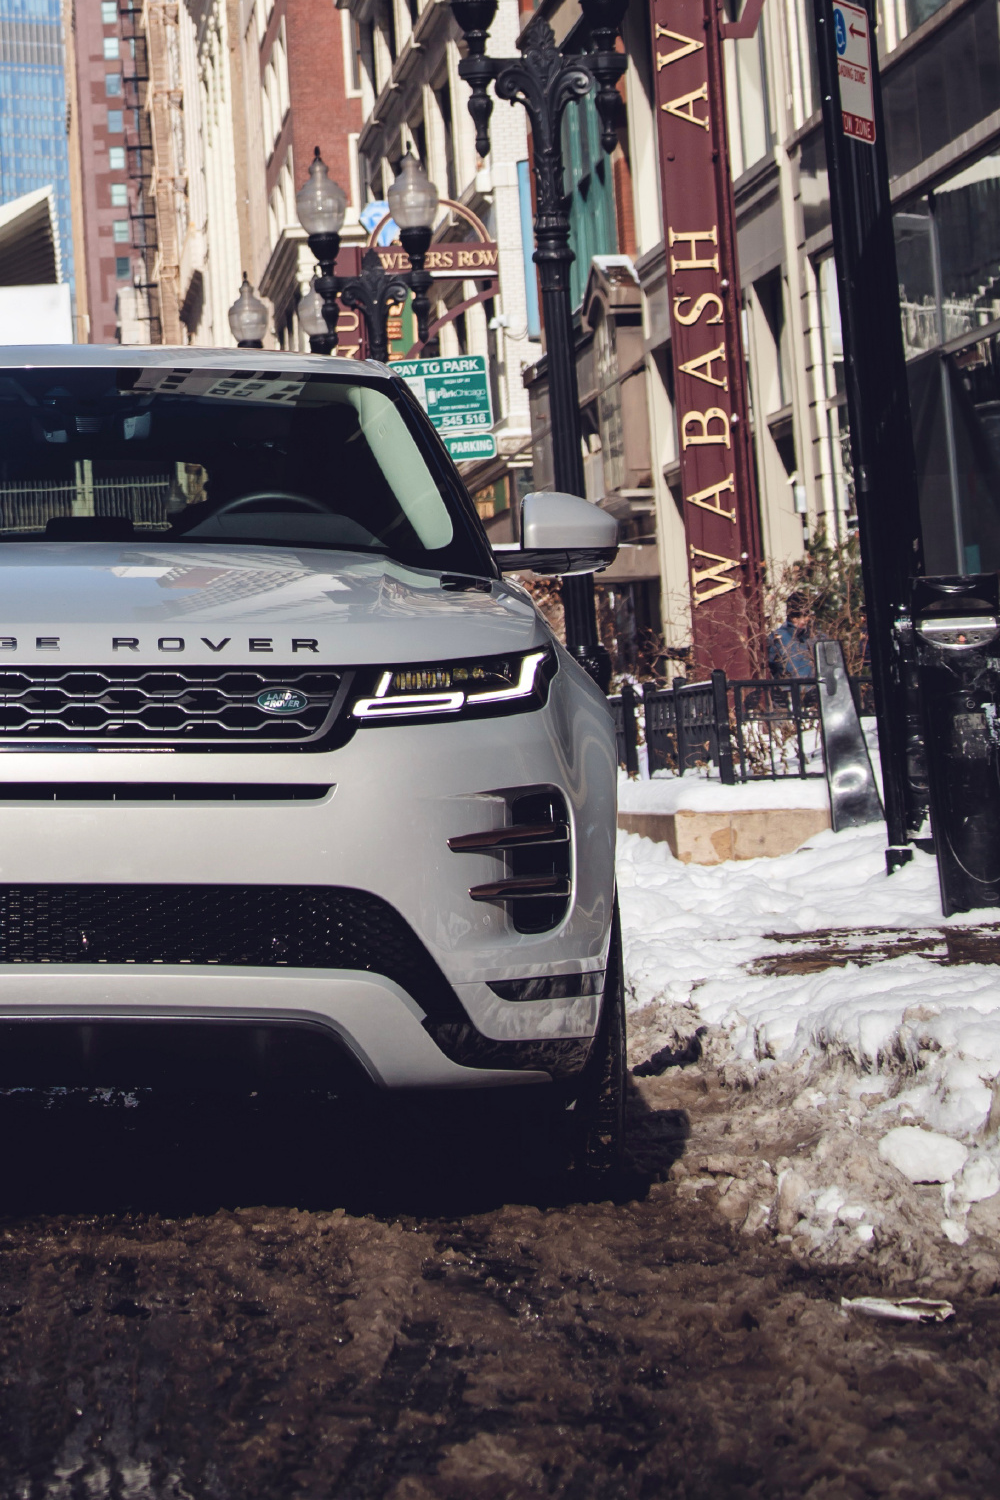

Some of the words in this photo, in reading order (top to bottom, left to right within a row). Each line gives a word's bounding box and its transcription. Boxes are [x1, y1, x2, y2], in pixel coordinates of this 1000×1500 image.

[854, 70, 867, 85] ZONE
[855, 117, 872, 139] ZONE
[457, 250, 499, 268] ROW
[392, 364, 419, 376] PAY
[421, 362, 441, 374] TO
[443, 359, 480, 372] PARK
[441, 415, 464, 427] 545
[465, 413, 487, 424] 516
[668, 225, 742, 609] WABASH
[450, 439, 493, 454] PARKING
[111, 636, 321, 653] ROVER
